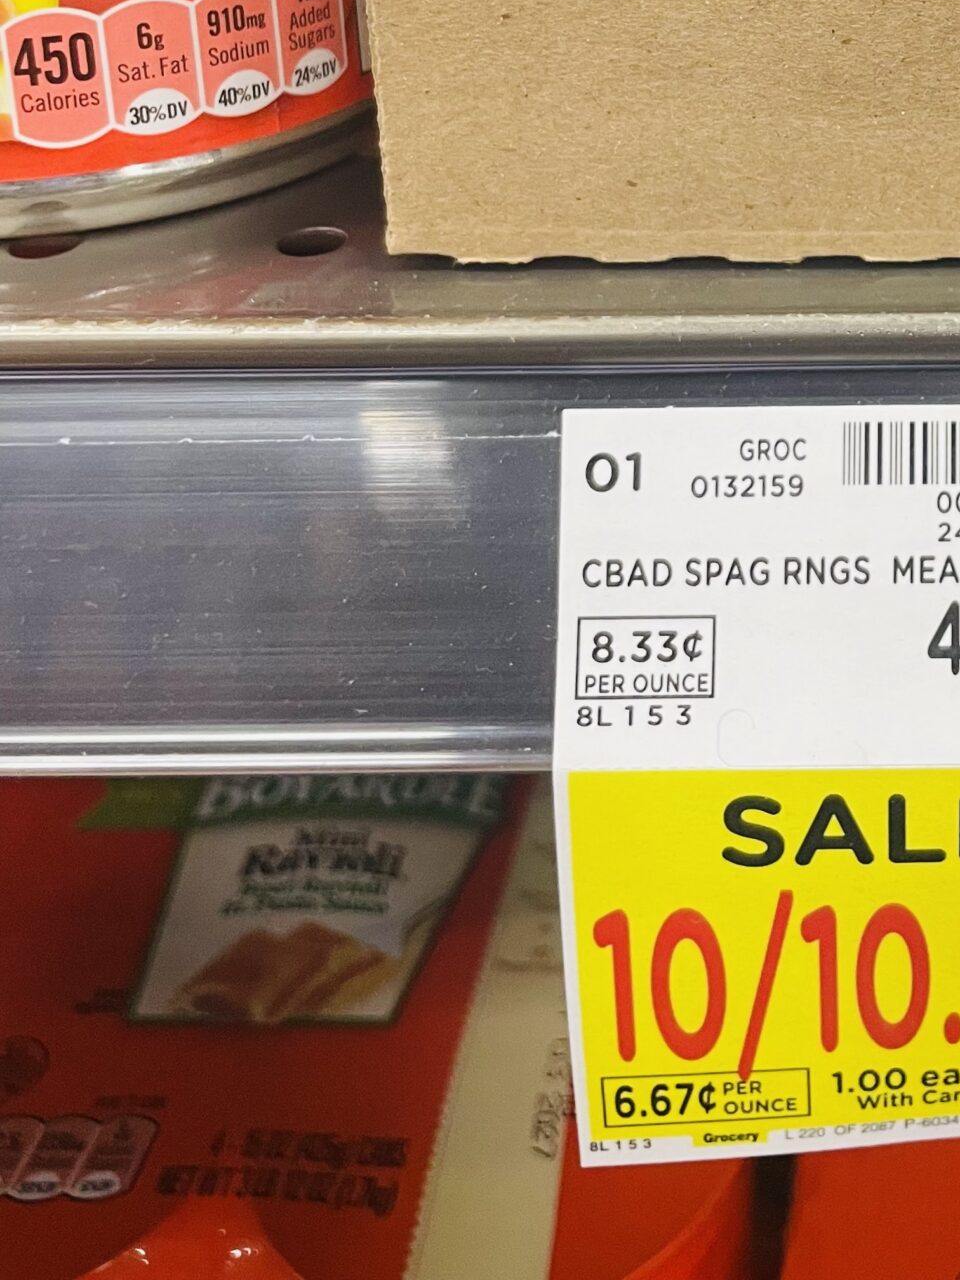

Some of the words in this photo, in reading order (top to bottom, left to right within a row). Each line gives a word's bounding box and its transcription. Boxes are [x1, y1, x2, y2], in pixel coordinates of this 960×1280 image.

[207, 5, 266, 36] 910mg
[289, 2, 331, 30] Added
[136, 22, 164, 51] 6g
[289, 24, 335, 52] Sugars
[14, 32, 95, 86] 450
[209, 38, 270, 66] Sodium
[118, 61, 155, 83] Sat.
[160, 55, 189, 76] Fat
[21, 89, 100, 113] Calories
[739, 439, 807, 462] GROC
[691, 474, 804, 499] 0132159
[581, 558, 673, 588] CBAD
[684, 558, 771, 587] SPAG
[783, 557, 871, 586] RNGS
[591, 629, 703, 665] 8.33¢
[584, 674, 625, 695] PER
[632, 673, 710, 694] OUNCE
[576, 705, 612, 728] 8L
[723, 1080, 762, 1096] PER
[832, 1067, 907, 1095] 1.00
[614, 1082, 716, 1119] 6.67¢
[724, 1098, 797, 1115] OUNCE
[857, 1093, 913, 1111] With
[703, 1131, 760, 1144] Grocery
[799, 1126, 826, 1139] 220
[834, 1122, 856, 1135] OF
[589, 1140, 609, 1152] 8L
